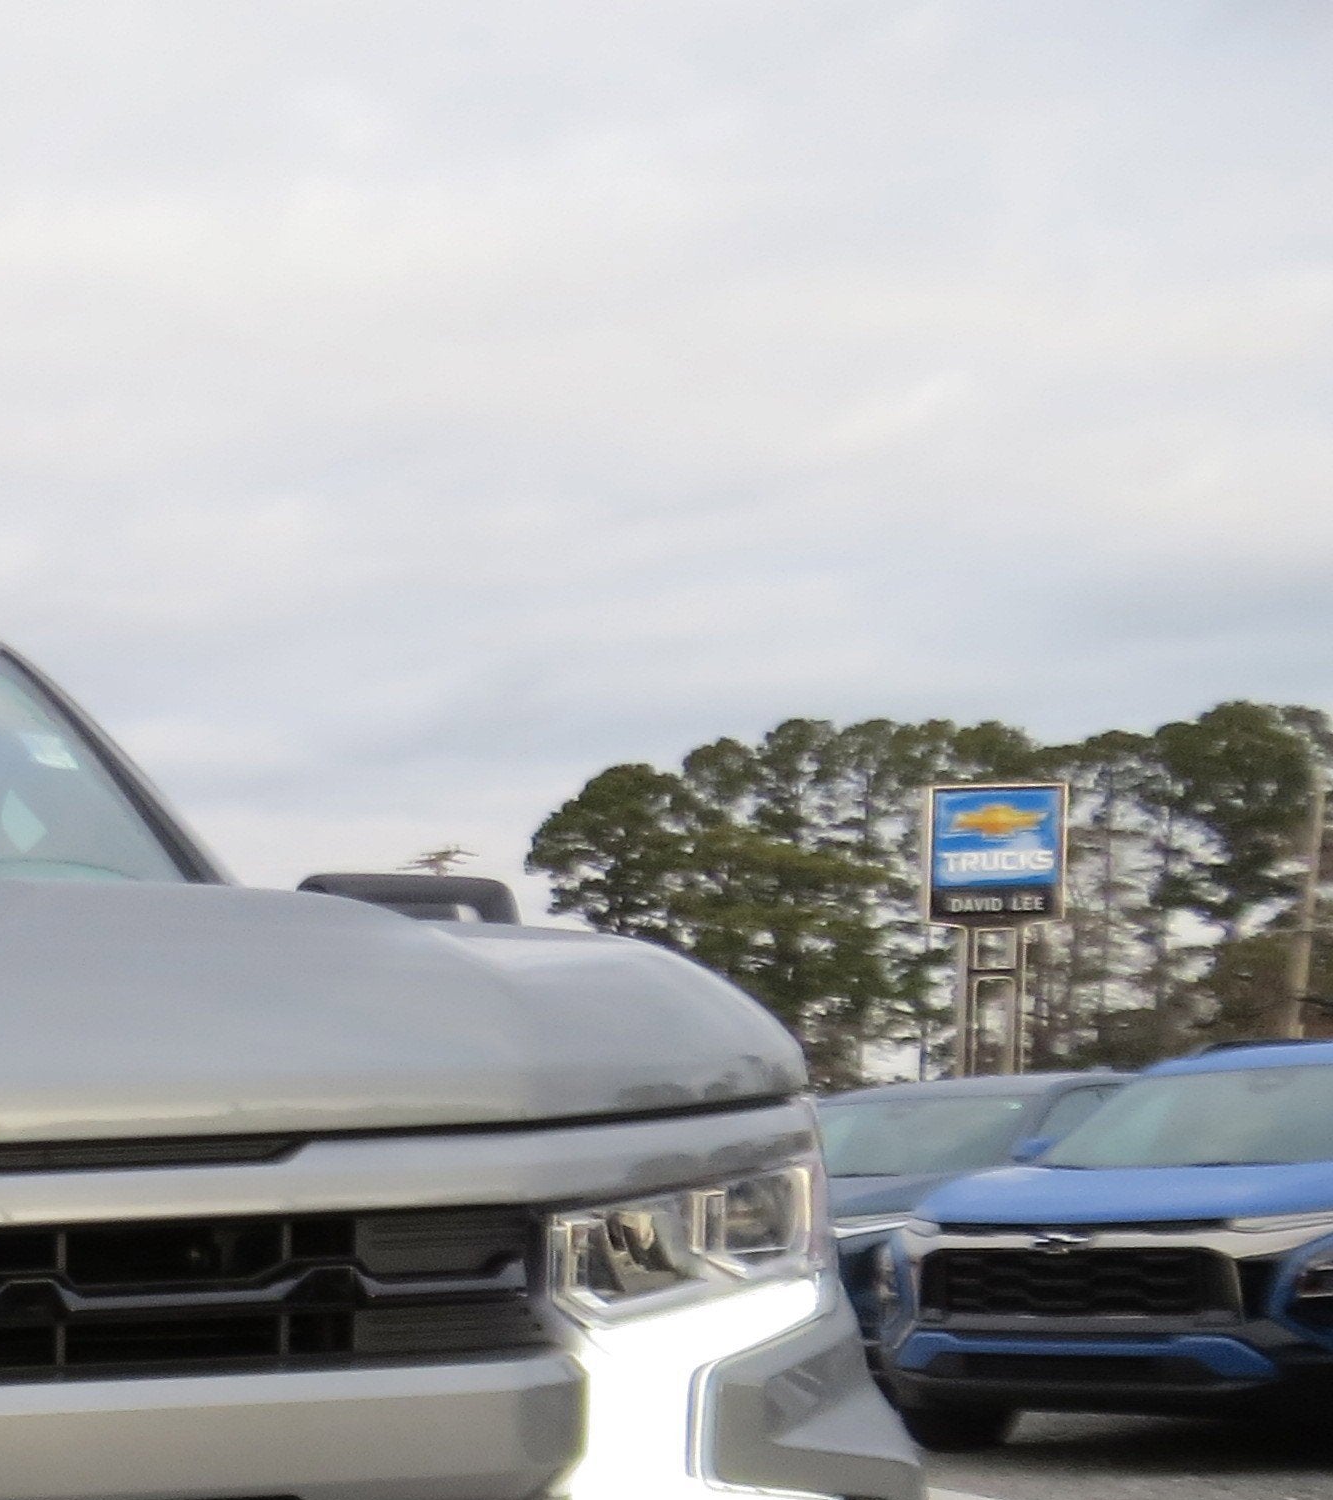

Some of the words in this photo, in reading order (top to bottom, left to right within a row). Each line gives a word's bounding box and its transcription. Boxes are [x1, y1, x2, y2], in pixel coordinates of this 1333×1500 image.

[941, 850, 1054, 872] TRUCKS
[950, 897, 1003, 912] DAVID
[1012, 896, 1045, 911] LEE
